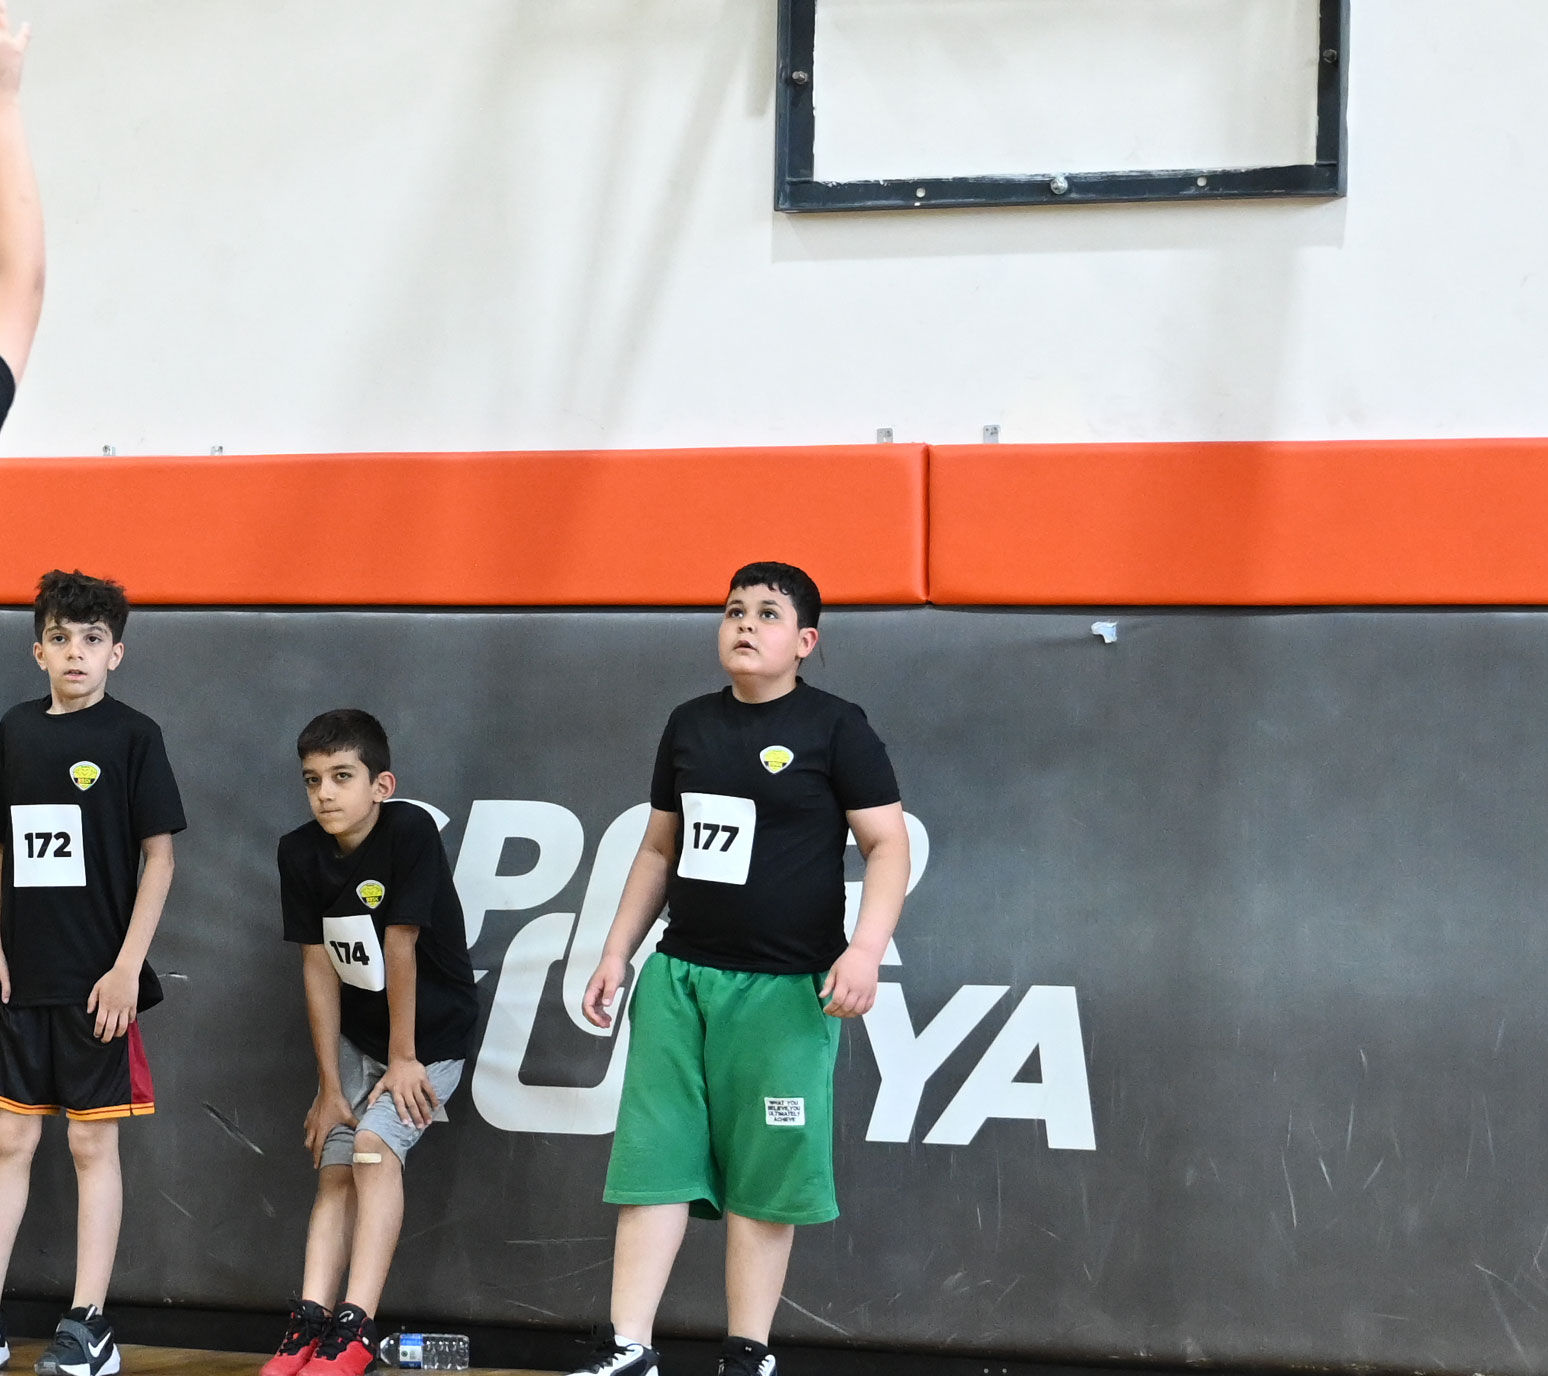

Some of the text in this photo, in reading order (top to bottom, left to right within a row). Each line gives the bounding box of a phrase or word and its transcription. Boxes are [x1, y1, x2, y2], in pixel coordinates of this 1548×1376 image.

[24, 831, 72, 858] 172
[693, 822, 739, 852] 177
[329, 940, 370, 965] 174
